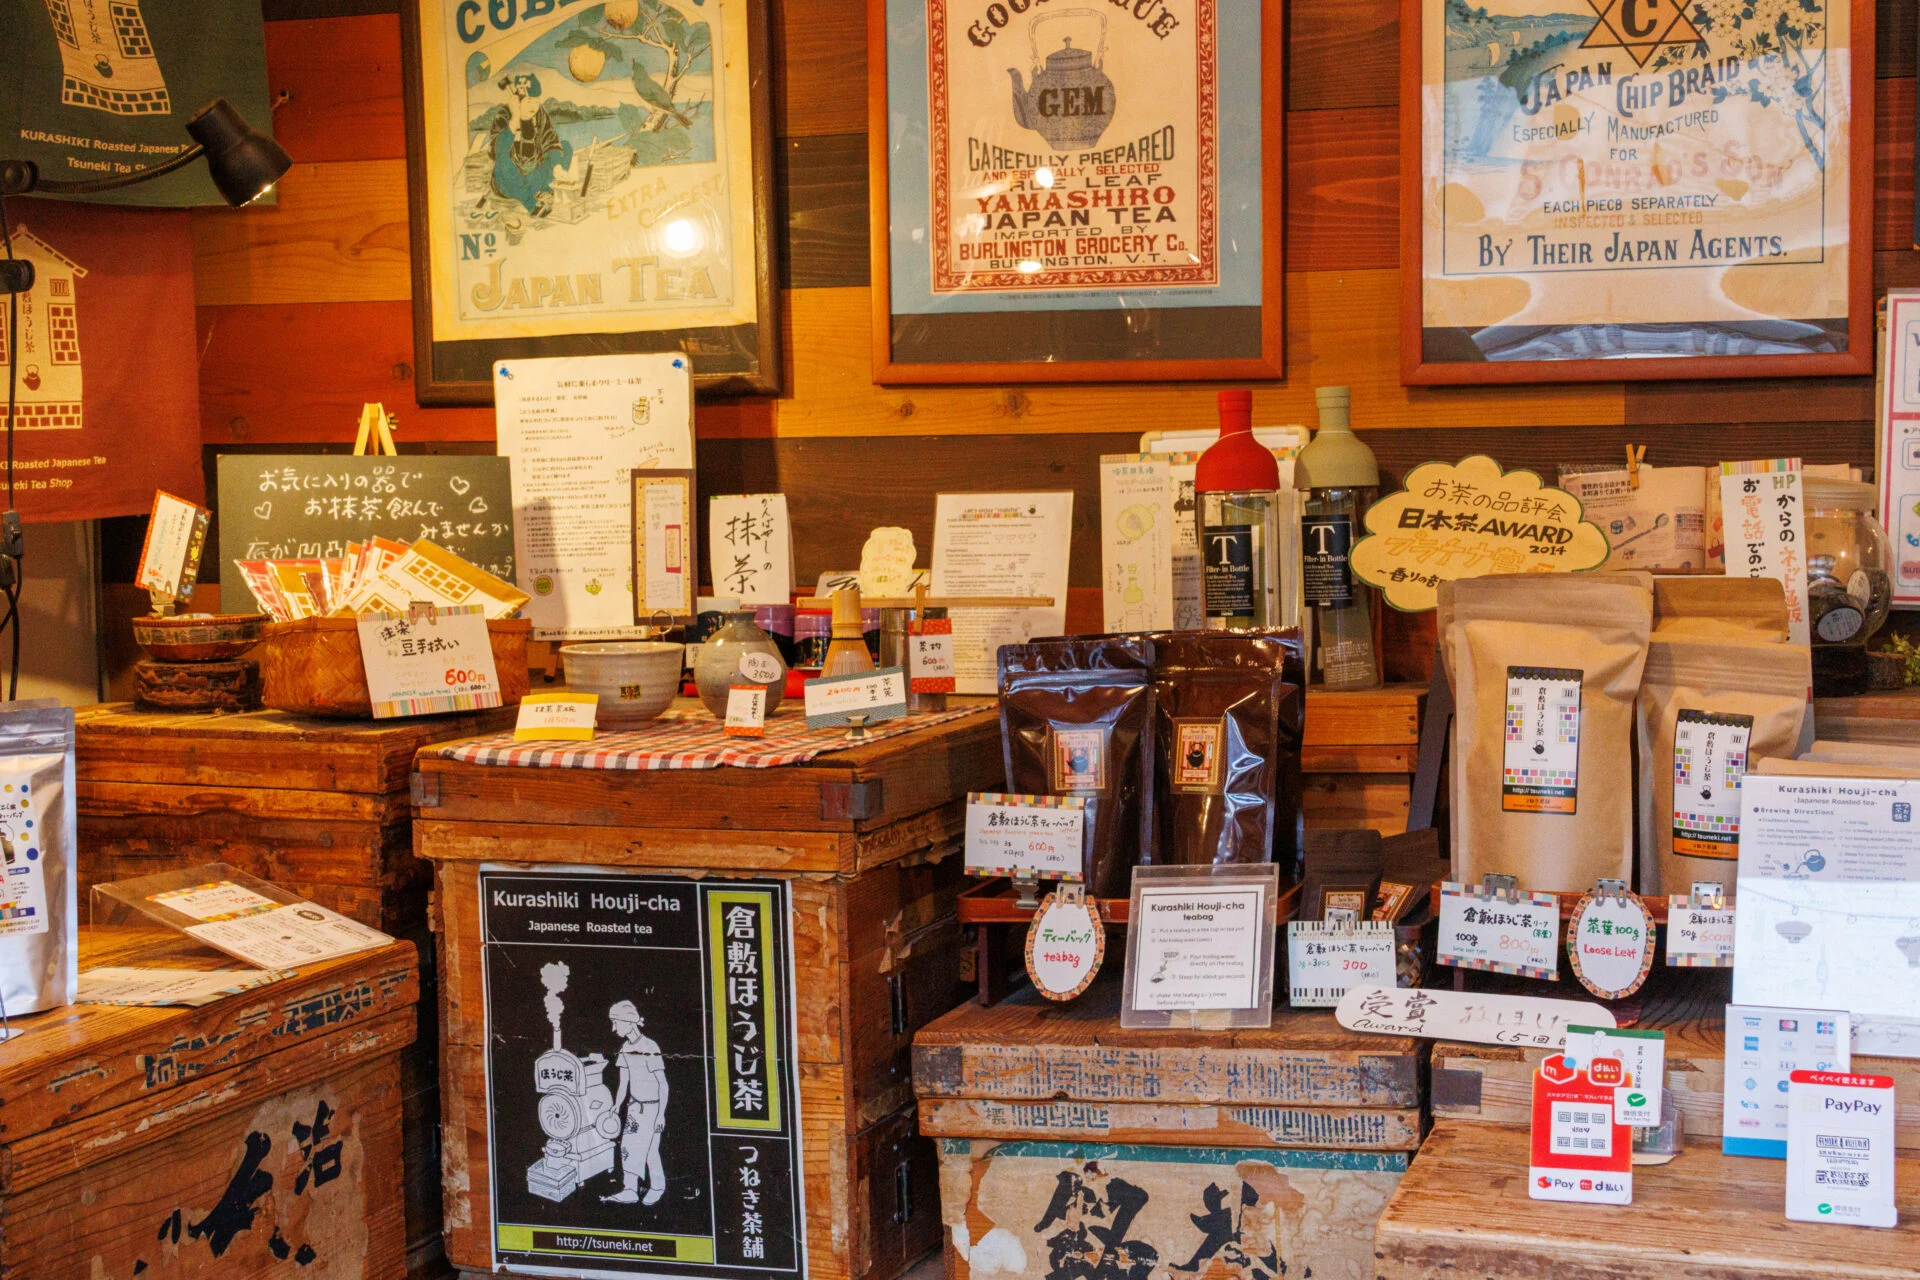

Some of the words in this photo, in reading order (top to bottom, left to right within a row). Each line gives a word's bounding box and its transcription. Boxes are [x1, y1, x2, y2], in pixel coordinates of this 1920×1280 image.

[1521, 61, 1612, 116] JAPAN
[1616, 72, 1664, 117] CHIP
[1668, 55, 1741, 107] BRAID
[1038, 86, 1106, 118] GEM
[1513, 111, 1596, 143] ESPECIALLY
[1607, 109, 1719, 143] MANUFACTURED
[20, 129, 90, 148] KURASHIKI
[93, 139, 136, 153] Roasted
[138, 143, 179, 155] Japanese
[968, 137, 1069, 171] CAREFULLY
[1079, 125, 1175, 166] PREPARED
[1610, 148, 1638, 161] FOR
[67, 156, 111, 172] Tsuneki
[114, 163, 131, 173] Tea
[983, 170, 1007, 181] AND
[1096, 163, 1160, 176] SELECTED
[1086, 174, 1162, 188] LEAF
[606, 176, 667, 221] EXTRA
[976, 186, 1176, 214] YAMASHIRO
[1544, 201, 1580, 214] EACH
[1632, 194, 1718, 210] SEPARATELY
[983, 209, 1090, 230] JAPAN
[1108, 206, 1176, 225] TEA
[1555, 214, 1625, 229] INSPECTED
[1643, 212, 1703, 226] SELECTED
[995, 227, 1102, 240] IMPORTED
[1121, 225, 1148, 235] BY
[960, 238, 1066, 262] BURLINGTON
[1076, 234, 1158, 255] GROCERY
[1479, 234, 1514, 267] BY
[1527, 233, 1592, 265] THEIR
[1605, 232, 1678, 263] JAPAN
[1689, 229, 1788, 260] AGENTS.
[470, 256, 603, 312] JAPAN
[612, 254, 718, 302] TEA
[12, 460, 50, 470] Roasted
[52, 457, 91, 469] Japanese
[93, 456, 107, 465] Tea
[31, 480, 47, 489] Tea
[50, 478, 73, 489] Shop
[259, 465, 422, 494] お気に入りの器で
[1424, 478, 1568, 523] お茶の品評会
[420, 520, 510, 539] みませんか
[1398, 507, 1574, 544] 日本茶AWARD
[1310, 525, 1336, 554] T
[724, 512, 761, 594] 抹茶
[1212, 535, 1238, 565] T
[1529, 545, 1567, 556] 2014
[1229, 565, 1250, 573] Bottle
[401, 637, 460, 656] 豆手拭い
[445, 668, 487, 686] 600円
[1778, 785, 1832, 795] Kurashiki
[1838, 787, 1897, 797] Houji-cha
[1832, 798, 1861, 807] Roasted
[1794, 808, 1834, 816] Directions
[1028, 842, 1055, 852] 600円
[493, 889, 580, 909] Kurashiki
[591, 893, 681, 914] Houji-cha
[1151, 903, 1194, 912] Kurashiki
[1197, 902, 1245, 912] Houji-cha
[1464, 907, 1532, 928] 倉敷ほうじ茶
[529, 921, 580, 934] Japanese
[586, 922, 632, 934] Roasted
[634, 923, 653, 934] tea
[1043, 928, 1092, 945] ティーバッグ
[1681, 930, 1697, 941] 50g
[1455, 933, 1478, 946] 100g
[1044, 952, 1080, 968] teabag
[1584, 944, 1612, 955] Loose
[1615, 947, 1637, 959] Leaf
[1343, 960, 1368, 970] 300
[725, 905, 764, 1112] 倉敷ほうじ茶
[1360, 990, 1438, 1023] 受賞
[541, 1068, 574, 1083] ほうじ茶
[1594, 1063, 1619, 1073] d払い
[1810, 1075, 1876, 1086] ペイペイ使えます
[1825, 1097, 1882, 1115] PayPay
[1554, 1179, 1574, 1190] Pay
[1595, 1181, 1624, 1192] d払い
[738, 1145, 765, 1259] つねき茶舗
[556, 1235, 654, 1253] http://tsuneki.net
